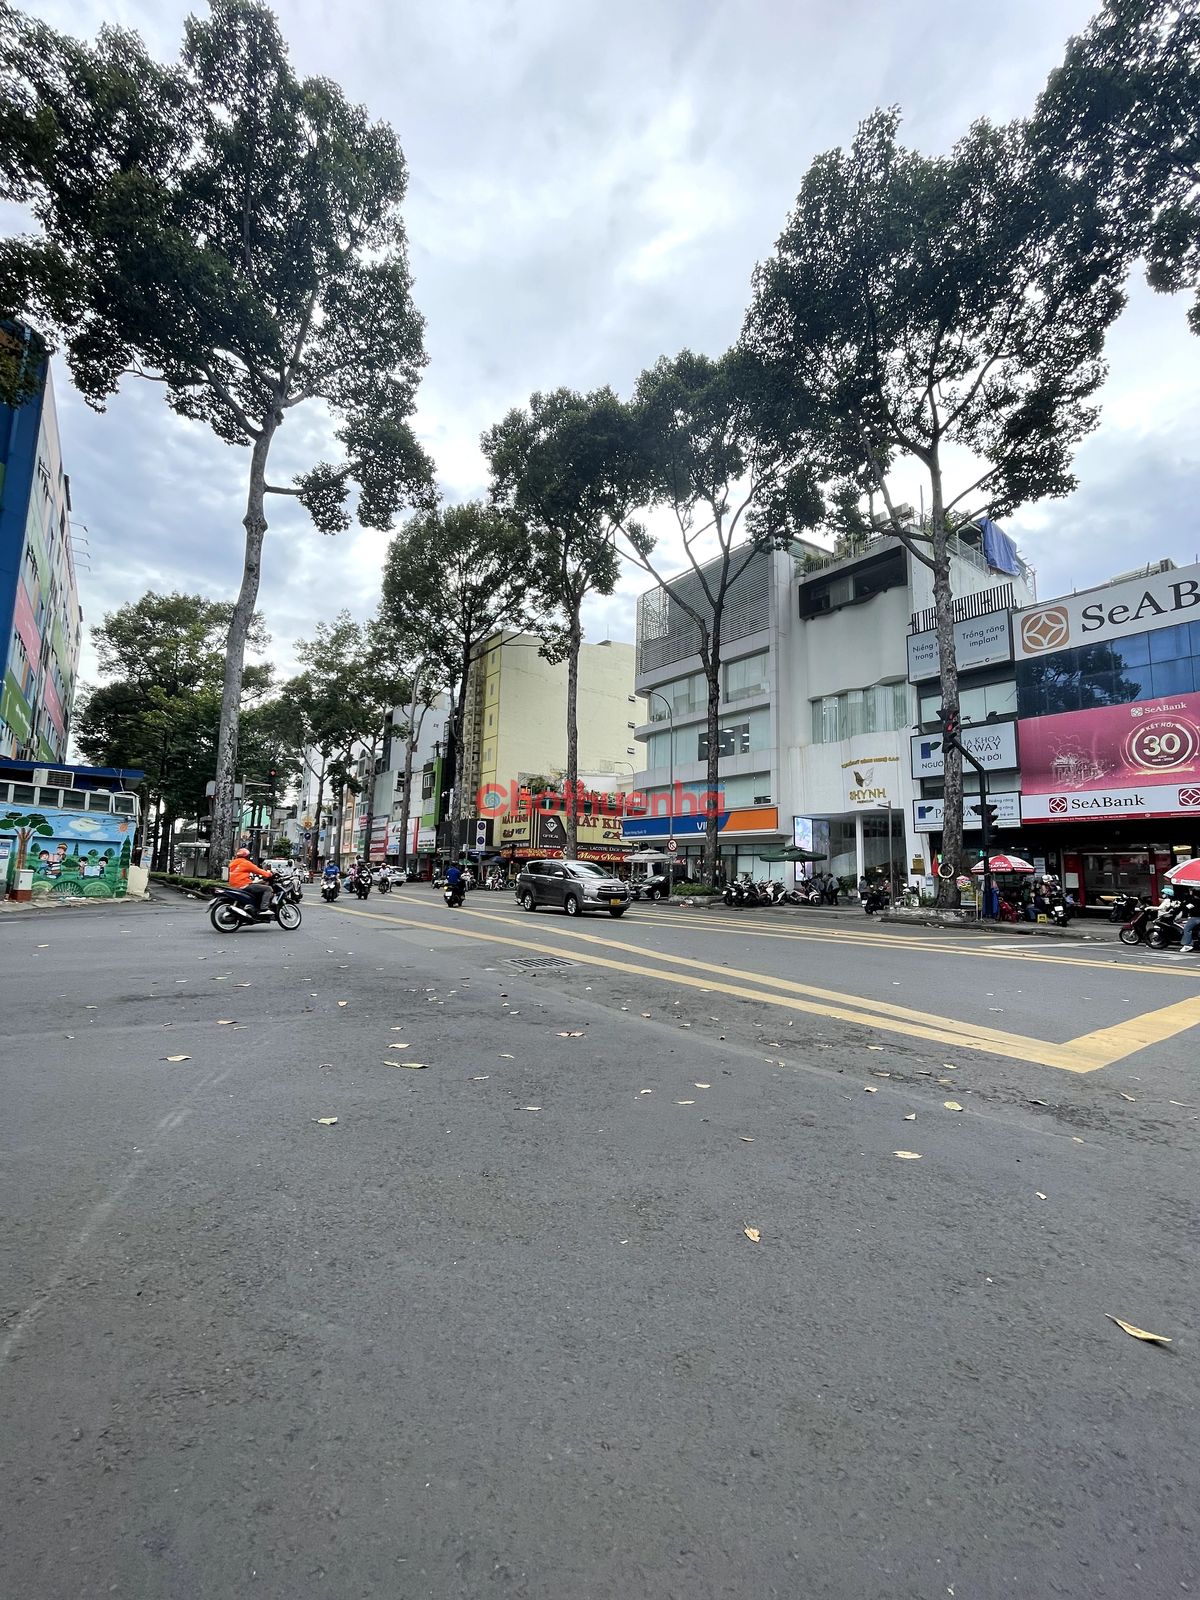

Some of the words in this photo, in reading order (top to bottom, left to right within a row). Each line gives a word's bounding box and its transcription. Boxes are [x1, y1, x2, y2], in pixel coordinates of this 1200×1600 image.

[1081, 580, 1200, 632] SeAB
[969, 635, 999, 647] implant
[915, 652, 934, 661] trong
[1144, 701, 1188, 714] SeABank
[974, 736, 1002, 744] KHOA
[1143, 733, 1181, 756] 30
[966, 741, 1001, 753] KWAY
[1071, 794, 1146, 810] SeABank
